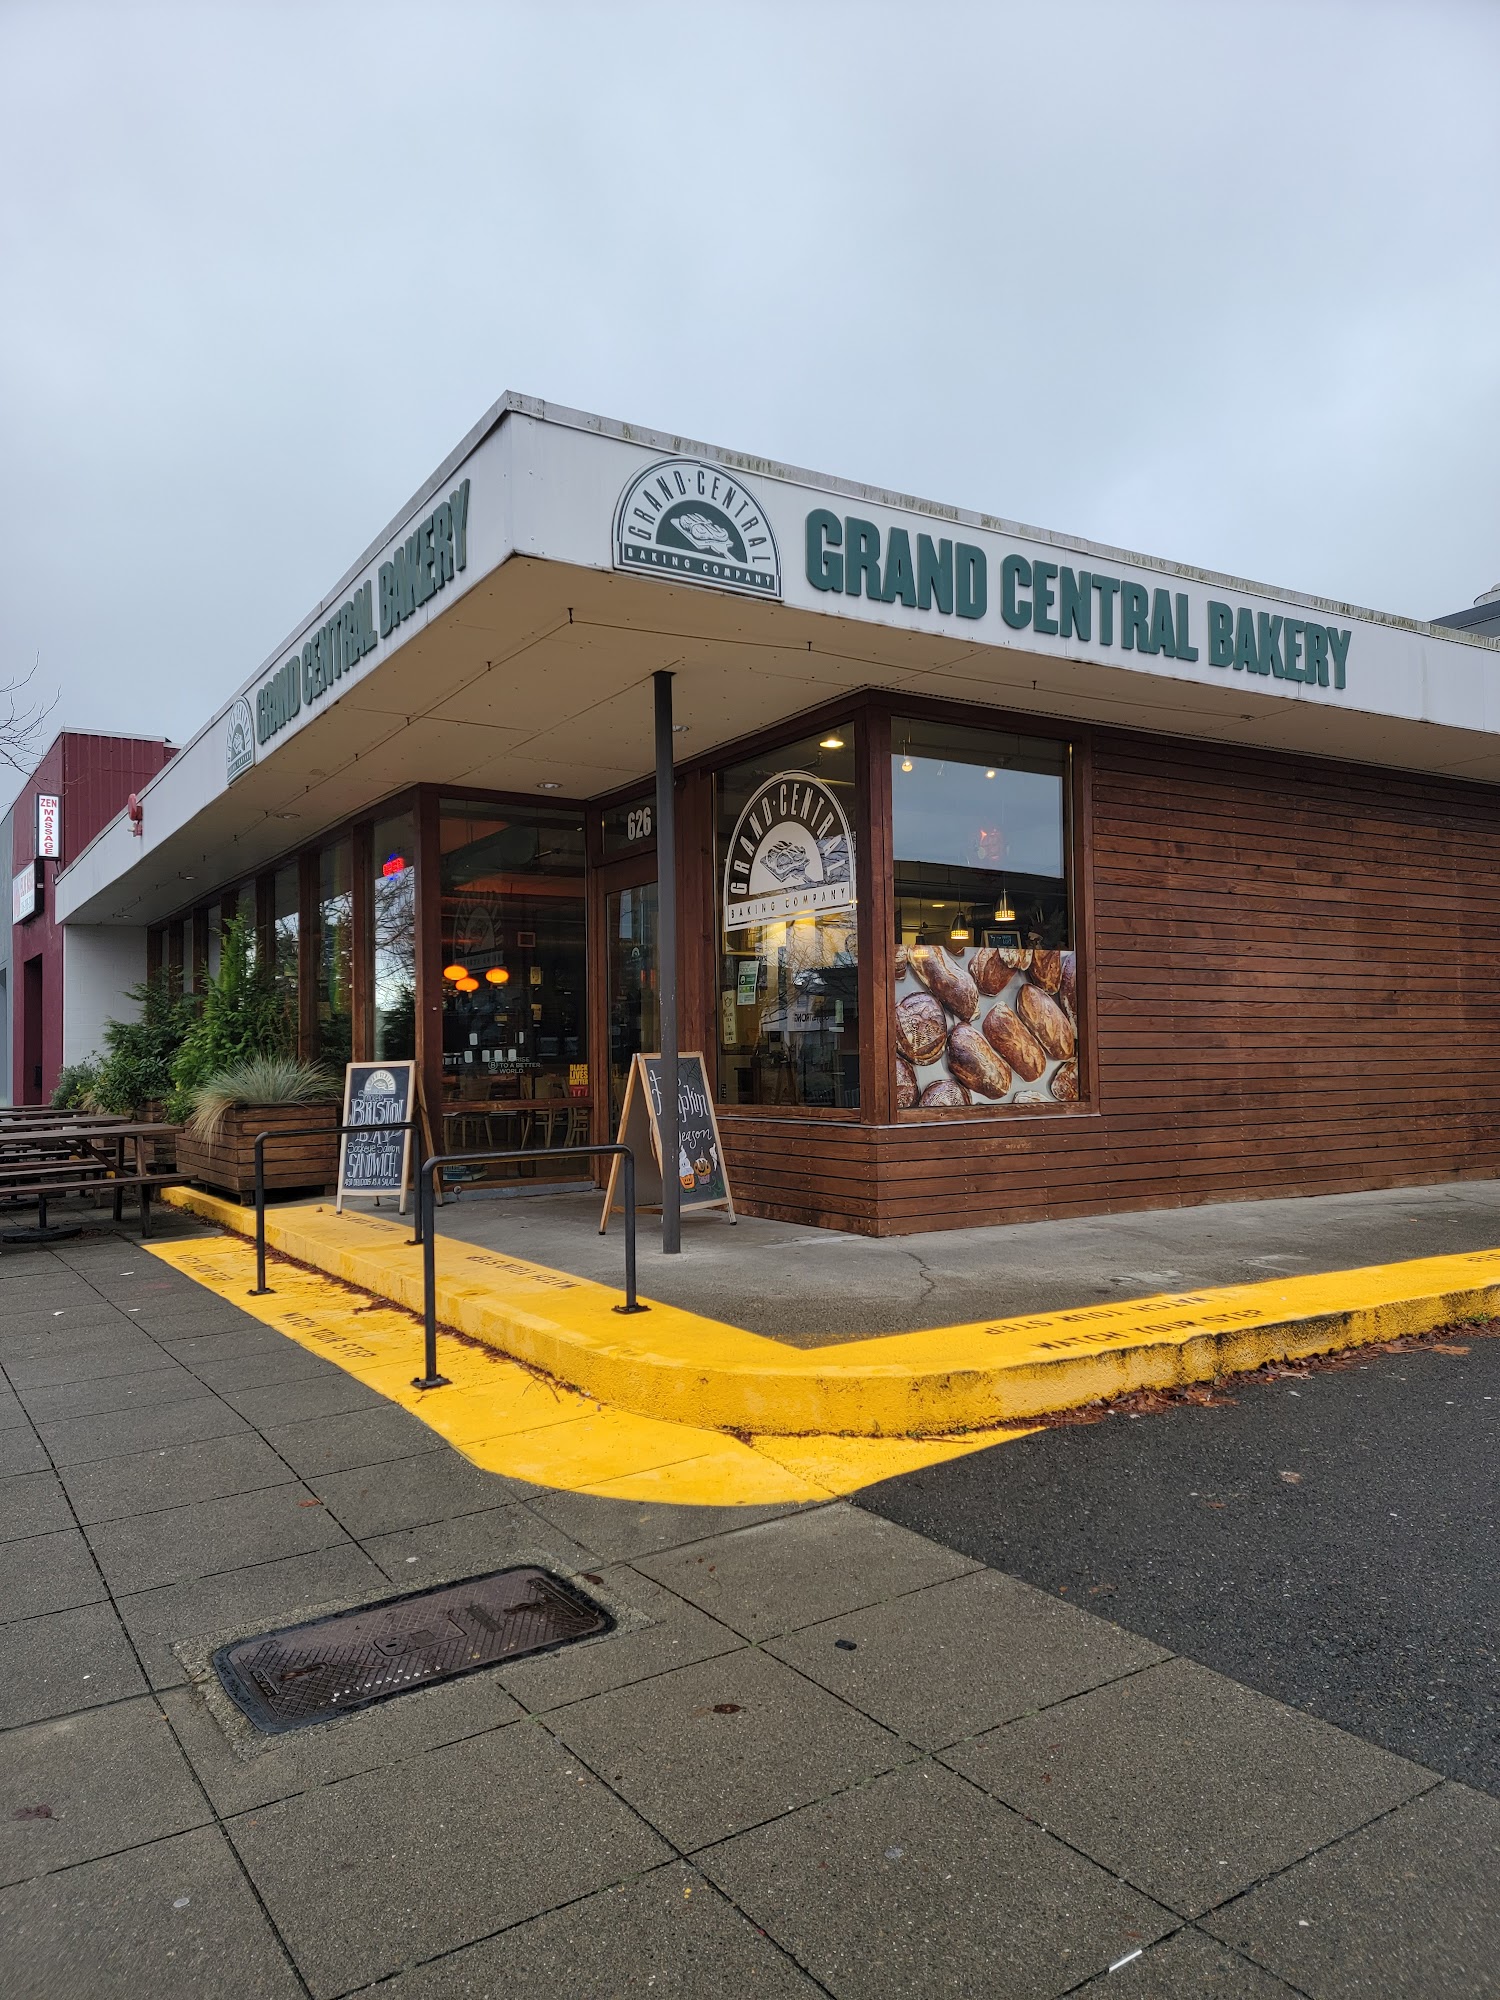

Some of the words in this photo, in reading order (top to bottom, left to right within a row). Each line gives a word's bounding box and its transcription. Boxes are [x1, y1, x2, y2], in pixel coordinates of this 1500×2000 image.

[627, 547, 690, 569] BAKING
[702, 562, 771, 586] COMPANY
[256, 655, 300, 745] GRAND
[301, 579, 378, 706] CENTRAL
[378, 478, 470, 639] BAKERY
[805, 508, 987, 620] GRAND
[1000, 553, 1198, 662] CENTRAL
[1207, 600, 1352, 690] BAKERY
[40, 798, 57, 808] ZEN
[44, 809, 54, 855] MASSAGE
[627, 806, 652, 841] 626
[731, 902, 776, 919] BAKING
[785, 887, 847, 909] COMPANY
[569, 1071, 588, 1079] LIVES
[1031, 1329, 1125, 1352] WATCH
[1130, 1319, 1204, 1336] YOUR
[1201, 1308, 1266, 1325] STEP
